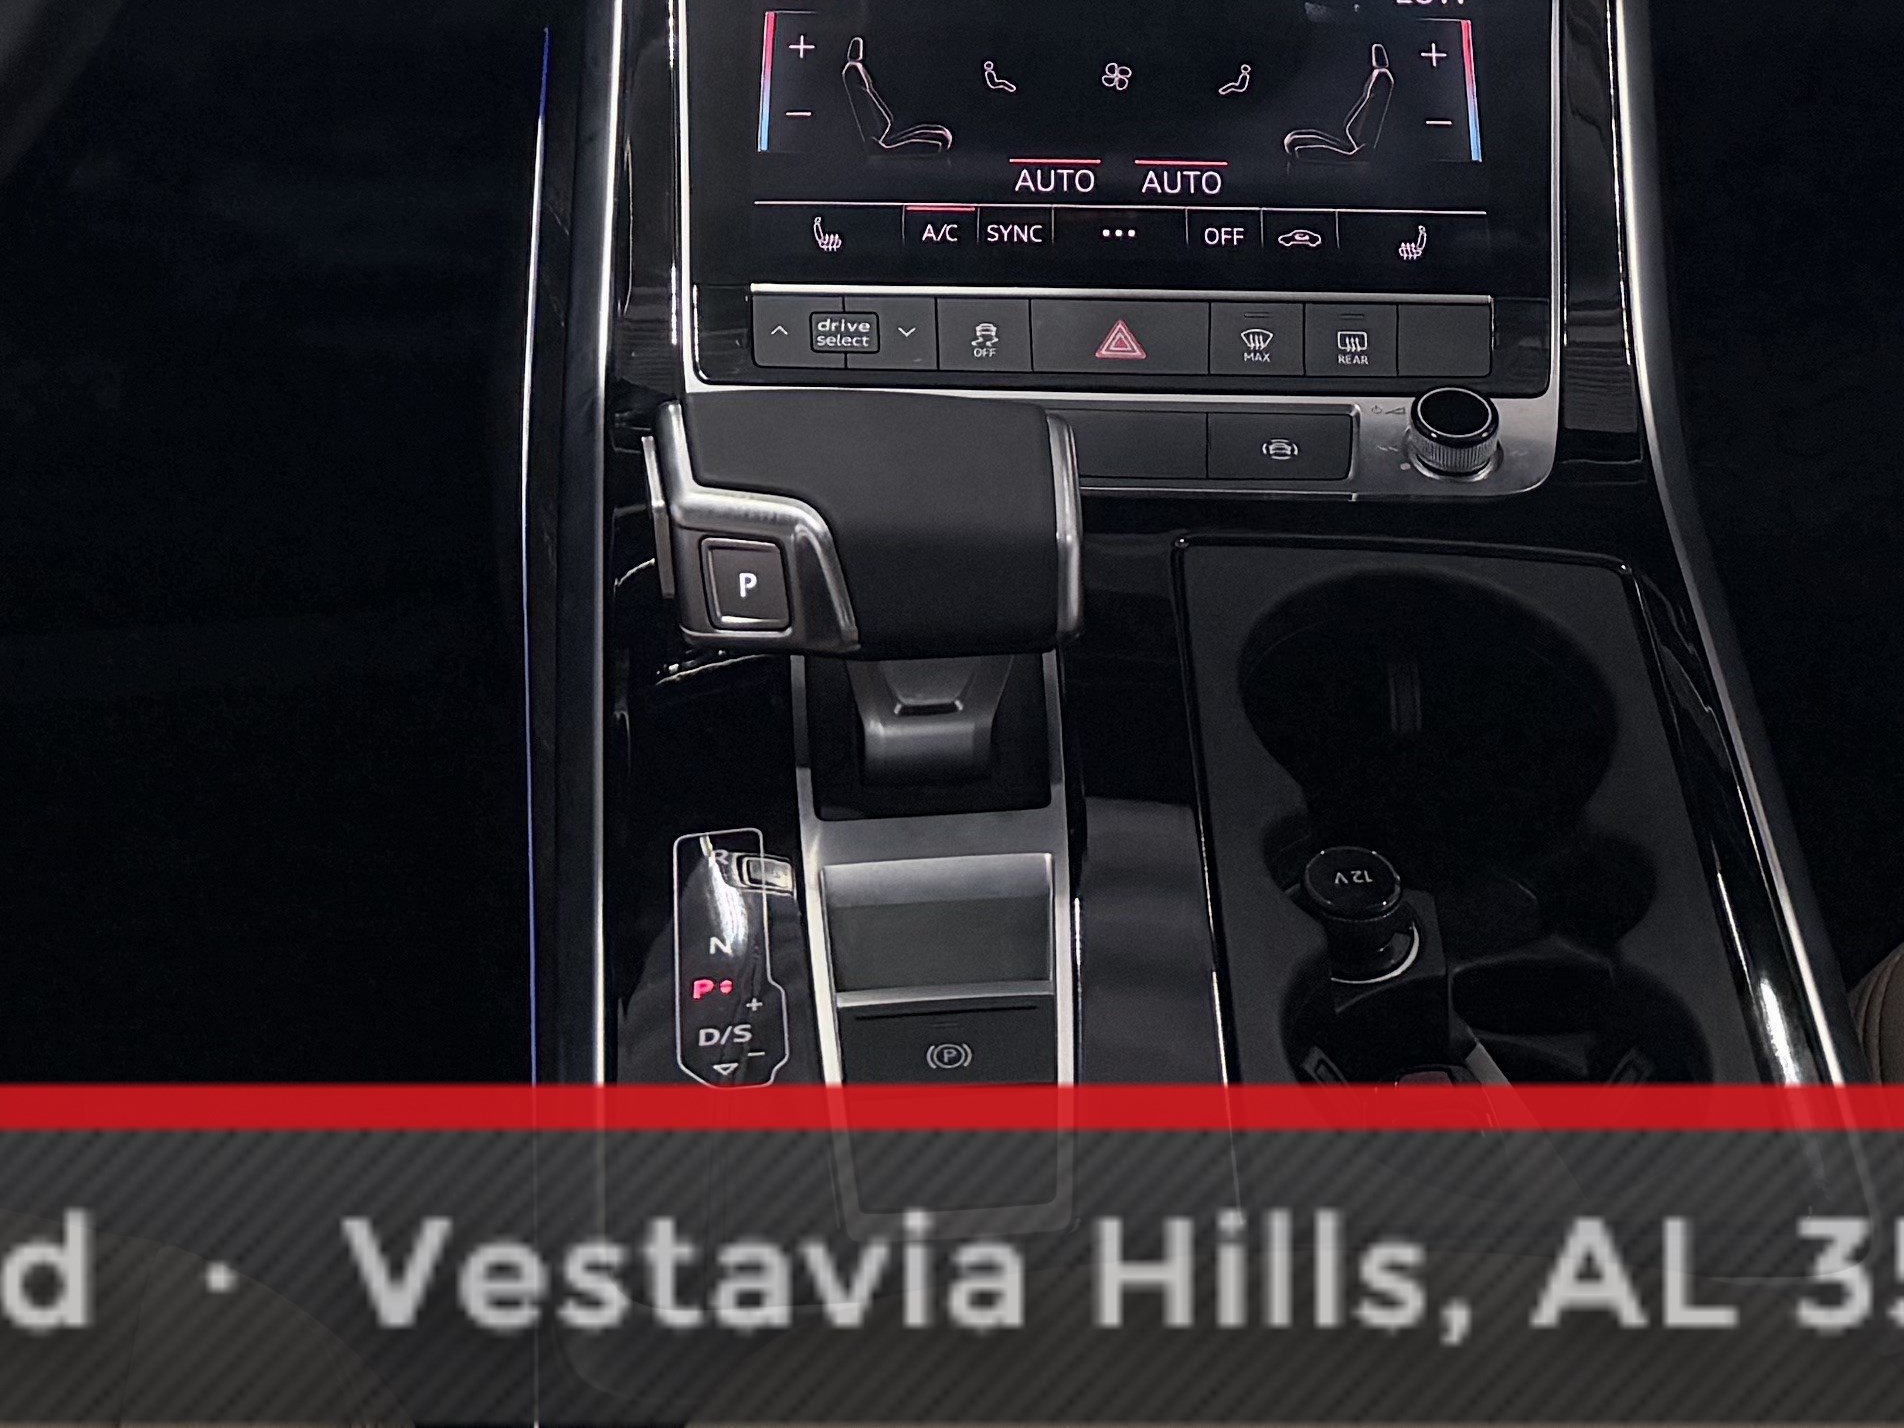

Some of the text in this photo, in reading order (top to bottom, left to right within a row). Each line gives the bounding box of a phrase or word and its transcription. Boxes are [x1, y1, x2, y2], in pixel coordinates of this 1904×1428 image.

[1014, 169, 1095, 193] AUTO
[1141, 171, 1222, 195] AUTO
[922, 223, 958, 243] A/C
[986, 224, 1043, 244] SYNC
[1204, 227, 1244, 245] OFF
[816, 318, 870, 333] drive
[816, 332, 869, 348] select
[973, 347, 996, 358] OFF
[1243, 351, 1270, 362] MAX
[1337, 354, 1369, 365] REAR
[739, 572, 757, 597] P
[710, 936, 733, 956] N
[692, 979, 715, 999] P
[698, 1024, 753, 1047] D/S
